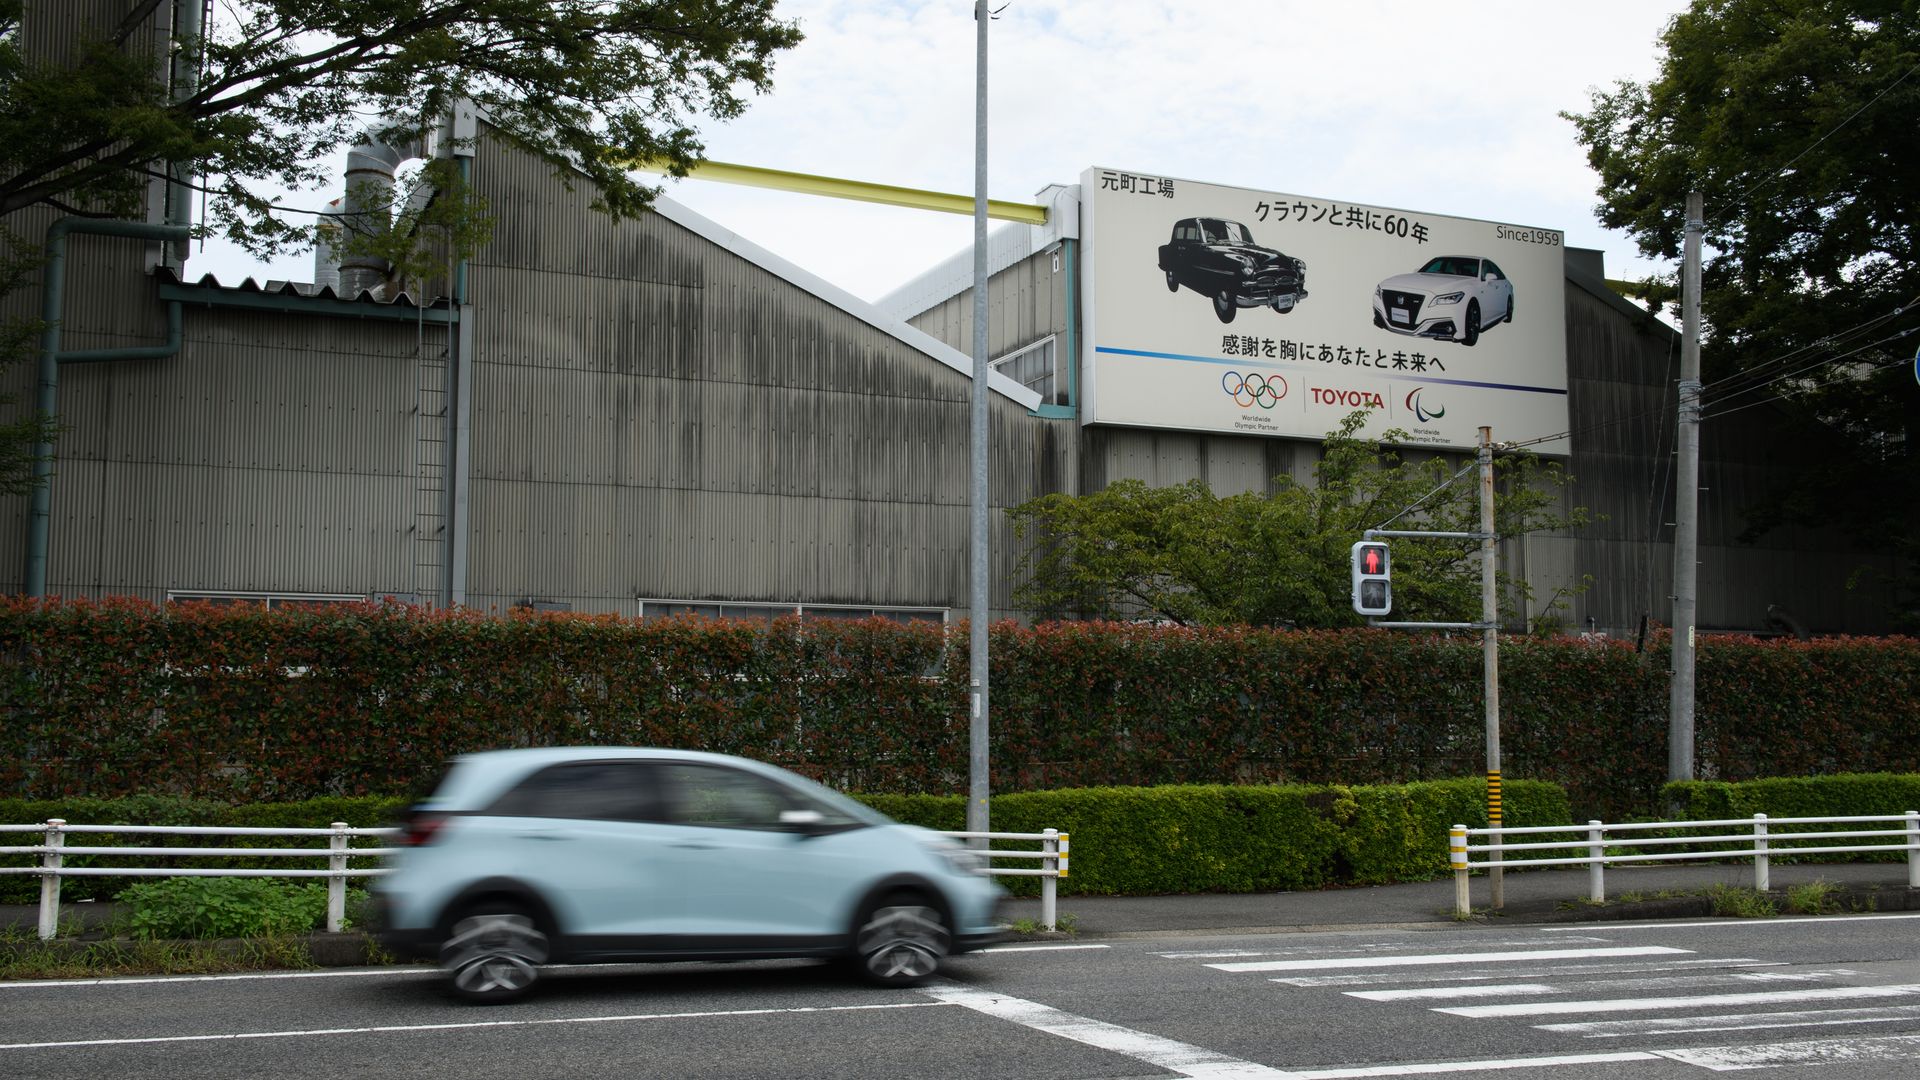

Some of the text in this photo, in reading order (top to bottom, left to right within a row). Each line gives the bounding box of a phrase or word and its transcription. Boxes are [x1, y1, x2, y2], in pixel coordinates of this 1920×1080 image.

[1101, 171, 1175, 199] 元町工場
[1255, 201, 1429, 245] クラウンと共に60年
[1496, 225, 1560, 247] Since1959
[1221, 334, 1446, 373] 感謝を胸にあなたと未来へ
[1310, 387, 1385, 409] TOYOTA
[1234, 421, 1280, 431] Olympic Partner
[1241, 414, 1272, 423] Worldwide
[1412, 428, 1440, 436] Worldwide
[1431, 436, 1452, 444] Partner
